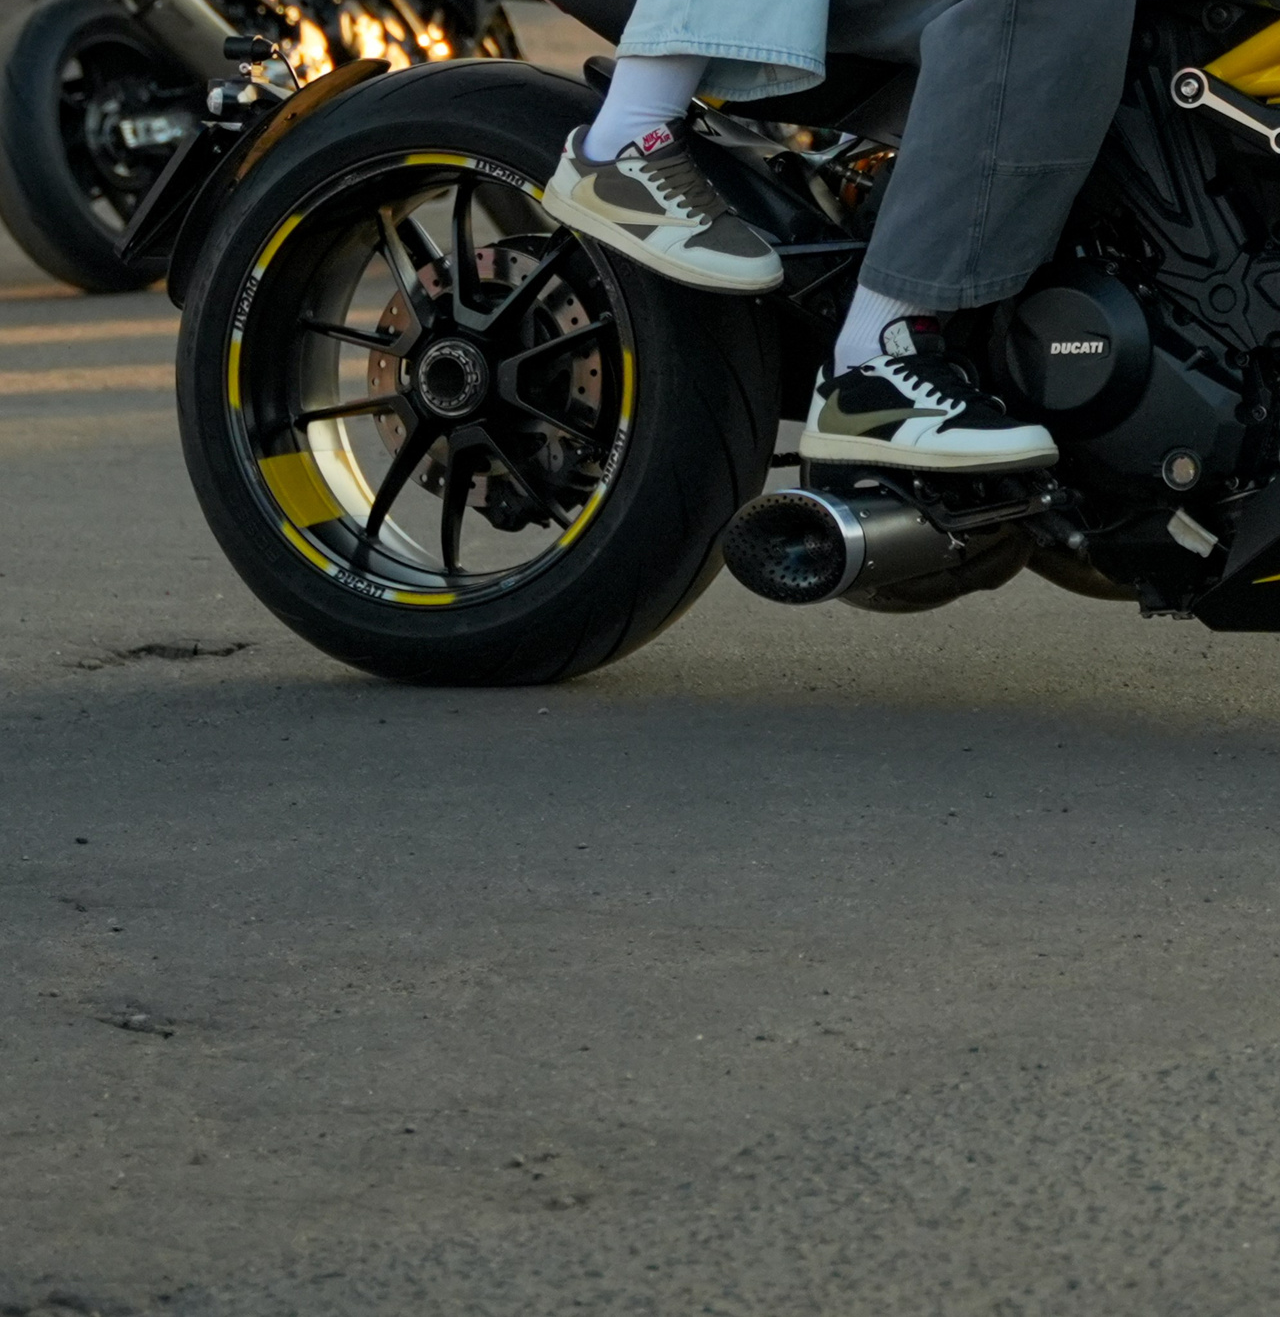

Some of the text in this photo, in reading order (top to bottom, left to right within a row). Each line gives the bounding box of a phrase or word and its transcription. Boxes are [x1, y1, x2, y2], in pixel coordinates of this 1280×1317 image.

[475, 159, 526, 188] DUCATI
[234, 275, 260, 333] DUCATI
[1050, 341, 1104, 354] DUCATI
[602, 428, 628, 484] DUCATI
[334, 569, 386, 599] DUCATI
